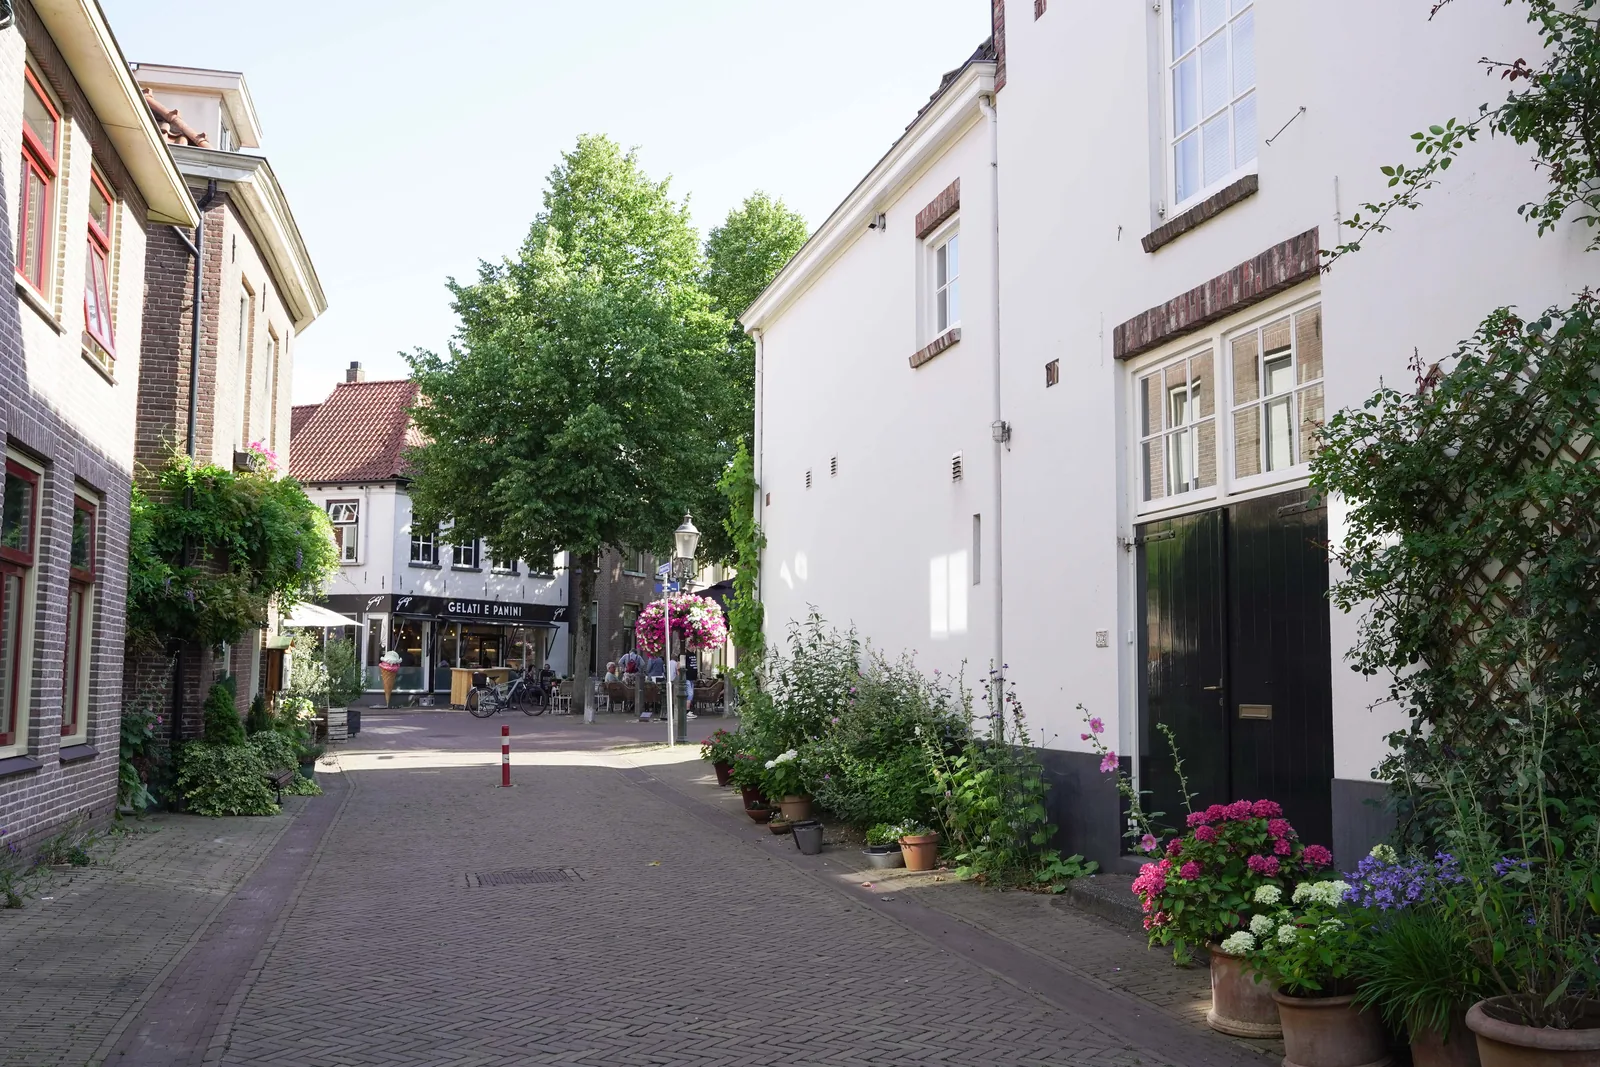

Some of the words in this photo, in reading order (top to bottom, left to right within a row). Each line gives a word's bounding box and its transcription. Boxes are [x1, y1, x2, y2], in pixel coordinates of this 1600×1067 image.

[447, 602, 480, 614] GELATI
[484, 604, 490, 615] E
[493, 605, 522, 617] PANINI
